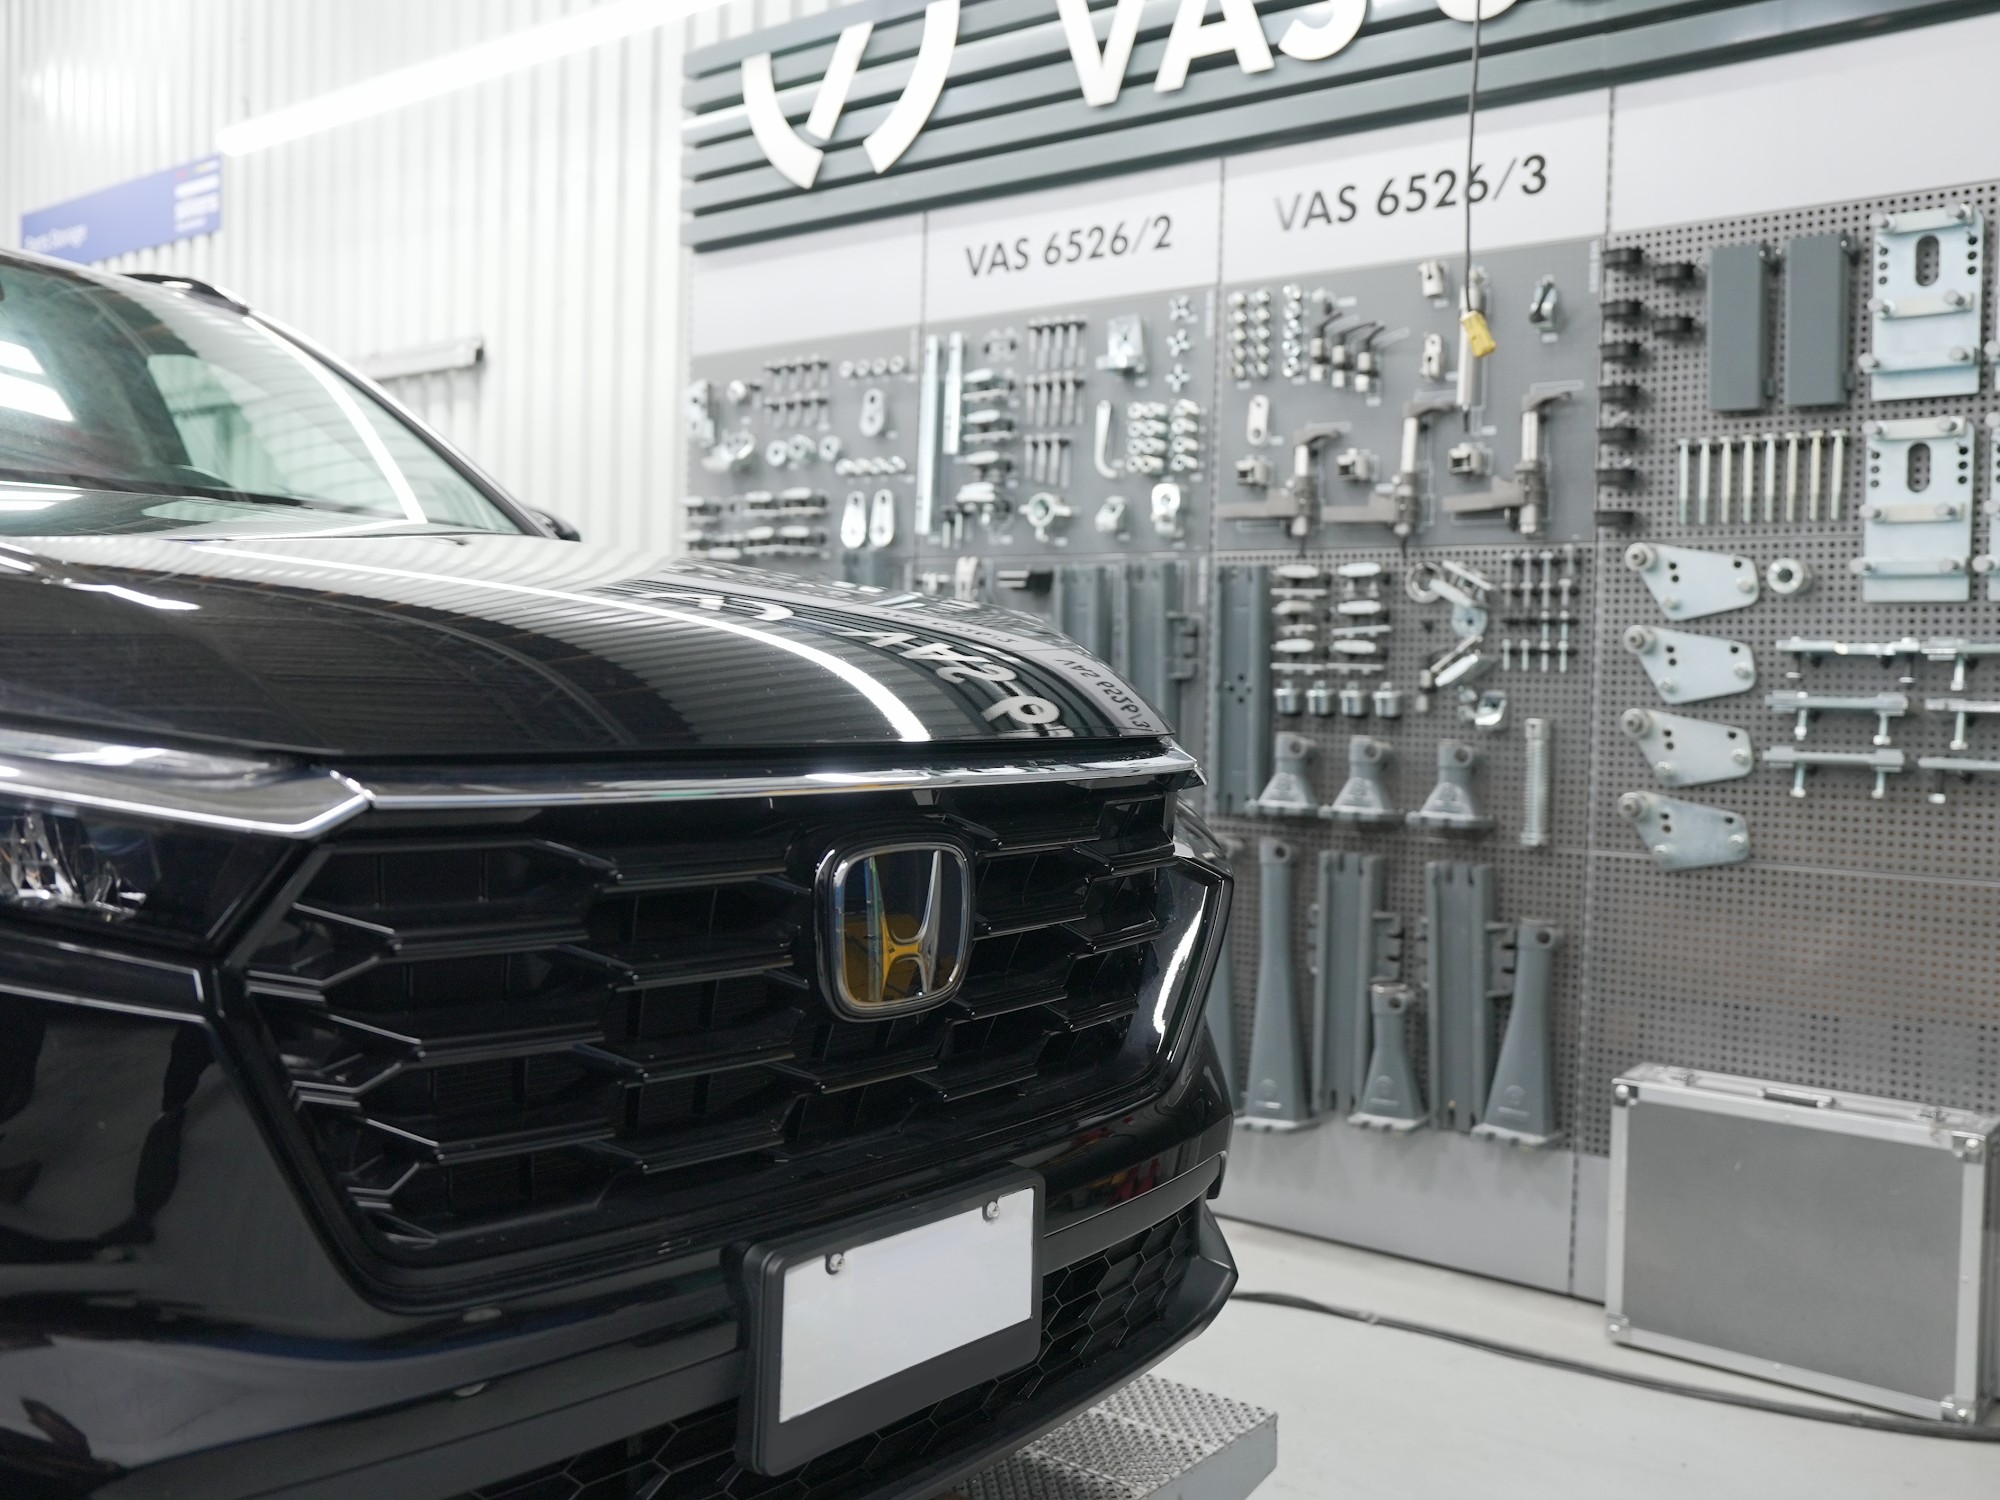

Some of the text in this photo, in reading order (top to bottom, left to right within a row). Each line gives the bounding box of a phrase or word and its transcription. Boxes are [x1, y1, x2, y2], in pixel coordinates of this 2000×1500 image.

[1274, 154, 1548, 231] VAS 6526/3
[966, 215, 1171, 277] VAS 6526/2
